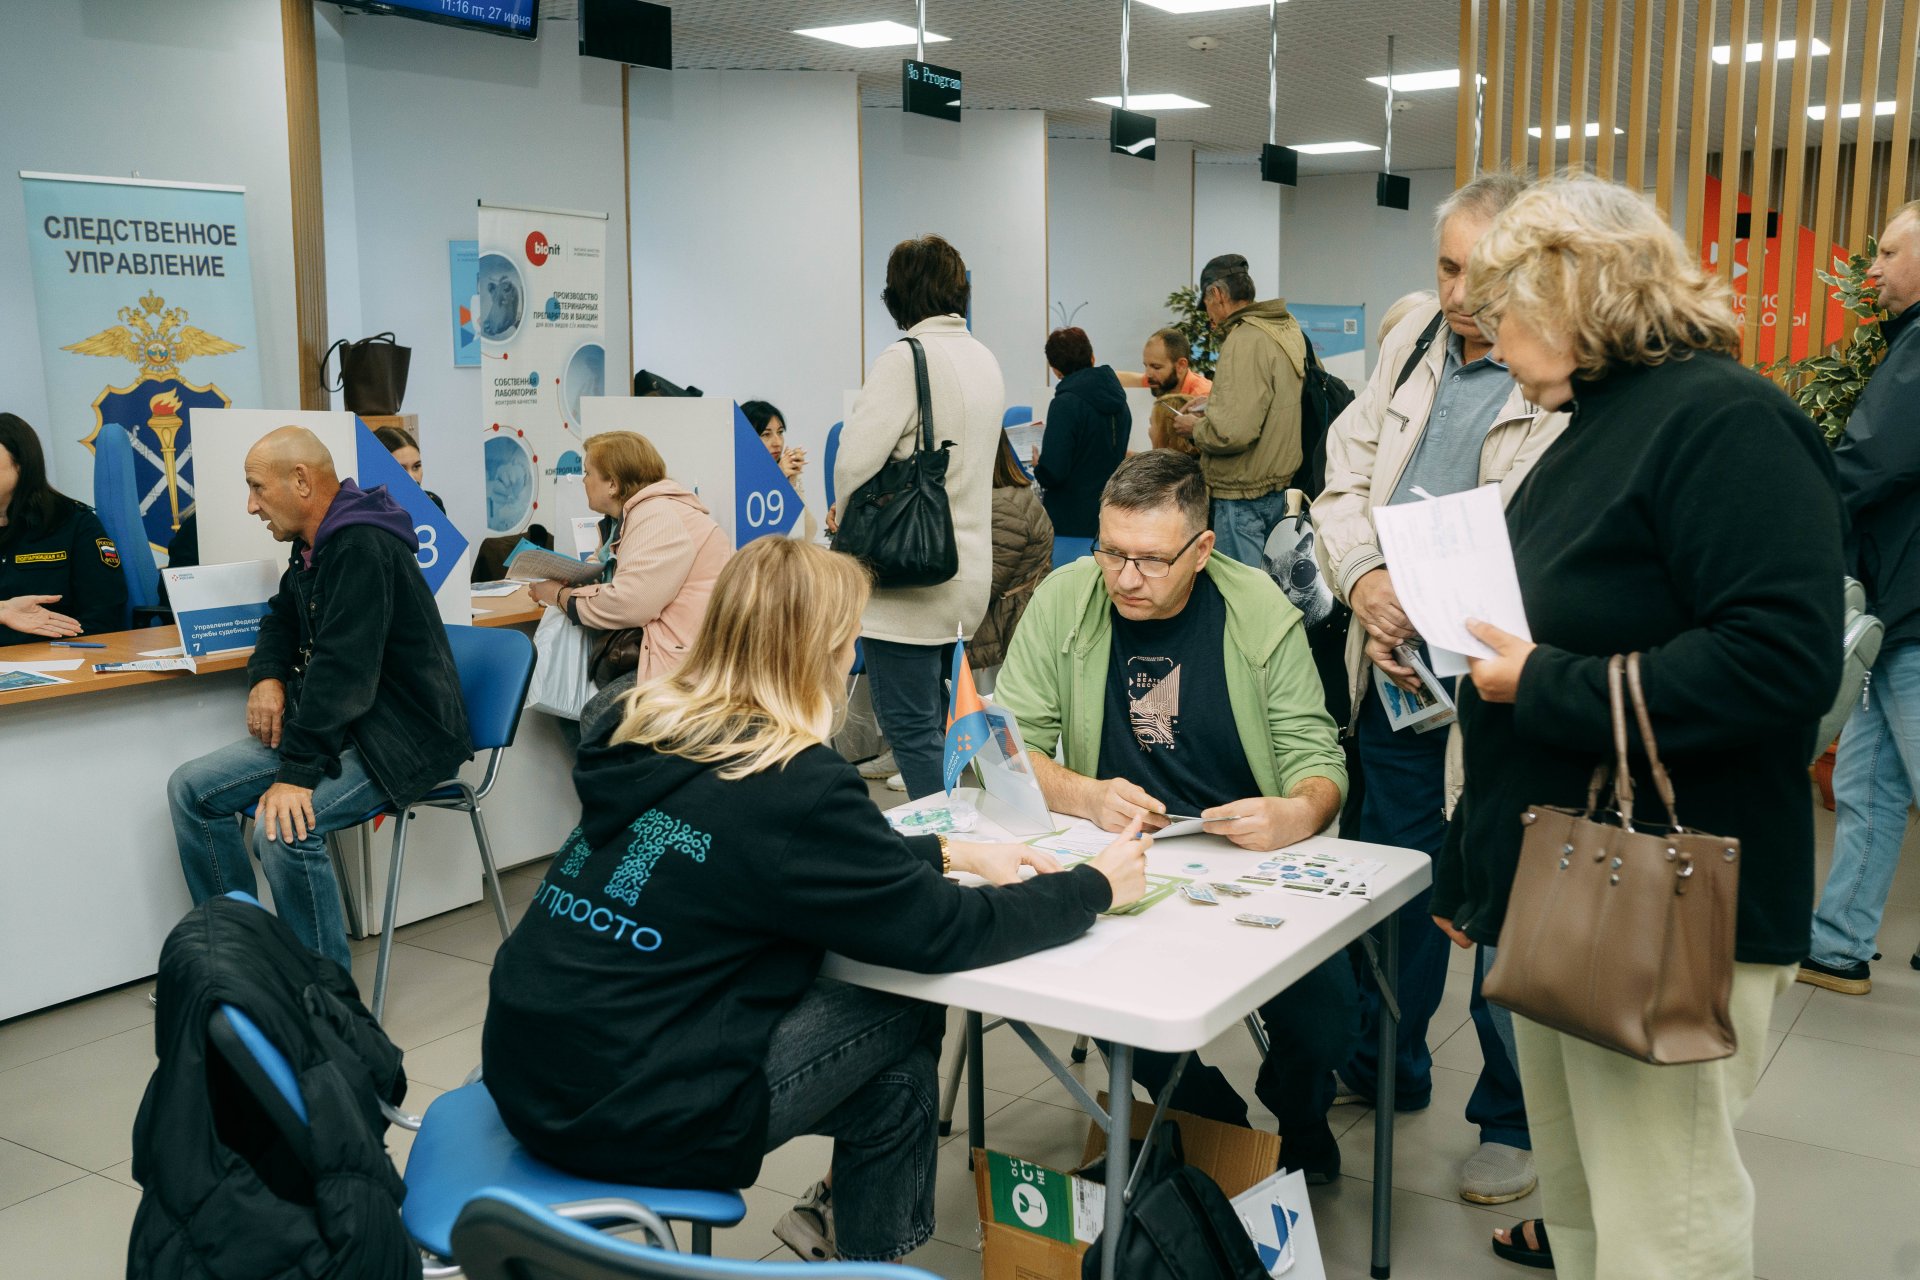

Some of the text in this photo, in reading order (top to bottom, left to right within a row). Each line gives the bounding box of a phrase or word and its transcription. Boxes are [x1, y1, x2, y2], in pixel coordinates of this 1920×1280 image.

[441, 0, 531, 26] 11:16 пт, 27 июня
[44, 215, 237, 246] СЛЕДСТВЕННОЕ
[534, 241, 560, 256] bionit
[65, 250, 225, 277] УПРАВЛЕНИЕ
[553, 291, 599, 301] ПРОИЗВОДСТВО
[554, 301, 599, 311] ВЕТЕРИНАРНЫХ
[533, 311, 599, 322] ПРЕПАРАТОВ И ВАКЦИН
[494, 377, 537, 387] СОБСТВЕННАЯ
[494, 388, 538, 397] ЛАБОРАТОРИЯ
[746, 489, 784, 528] 09
[193, 621, 234, 631] Управление
[191, 630, 218, 640] службы
[218, 626, 250, 637] судебных
[193, 643, 201, 652] 7
[540, 883, 663, 952] просто
